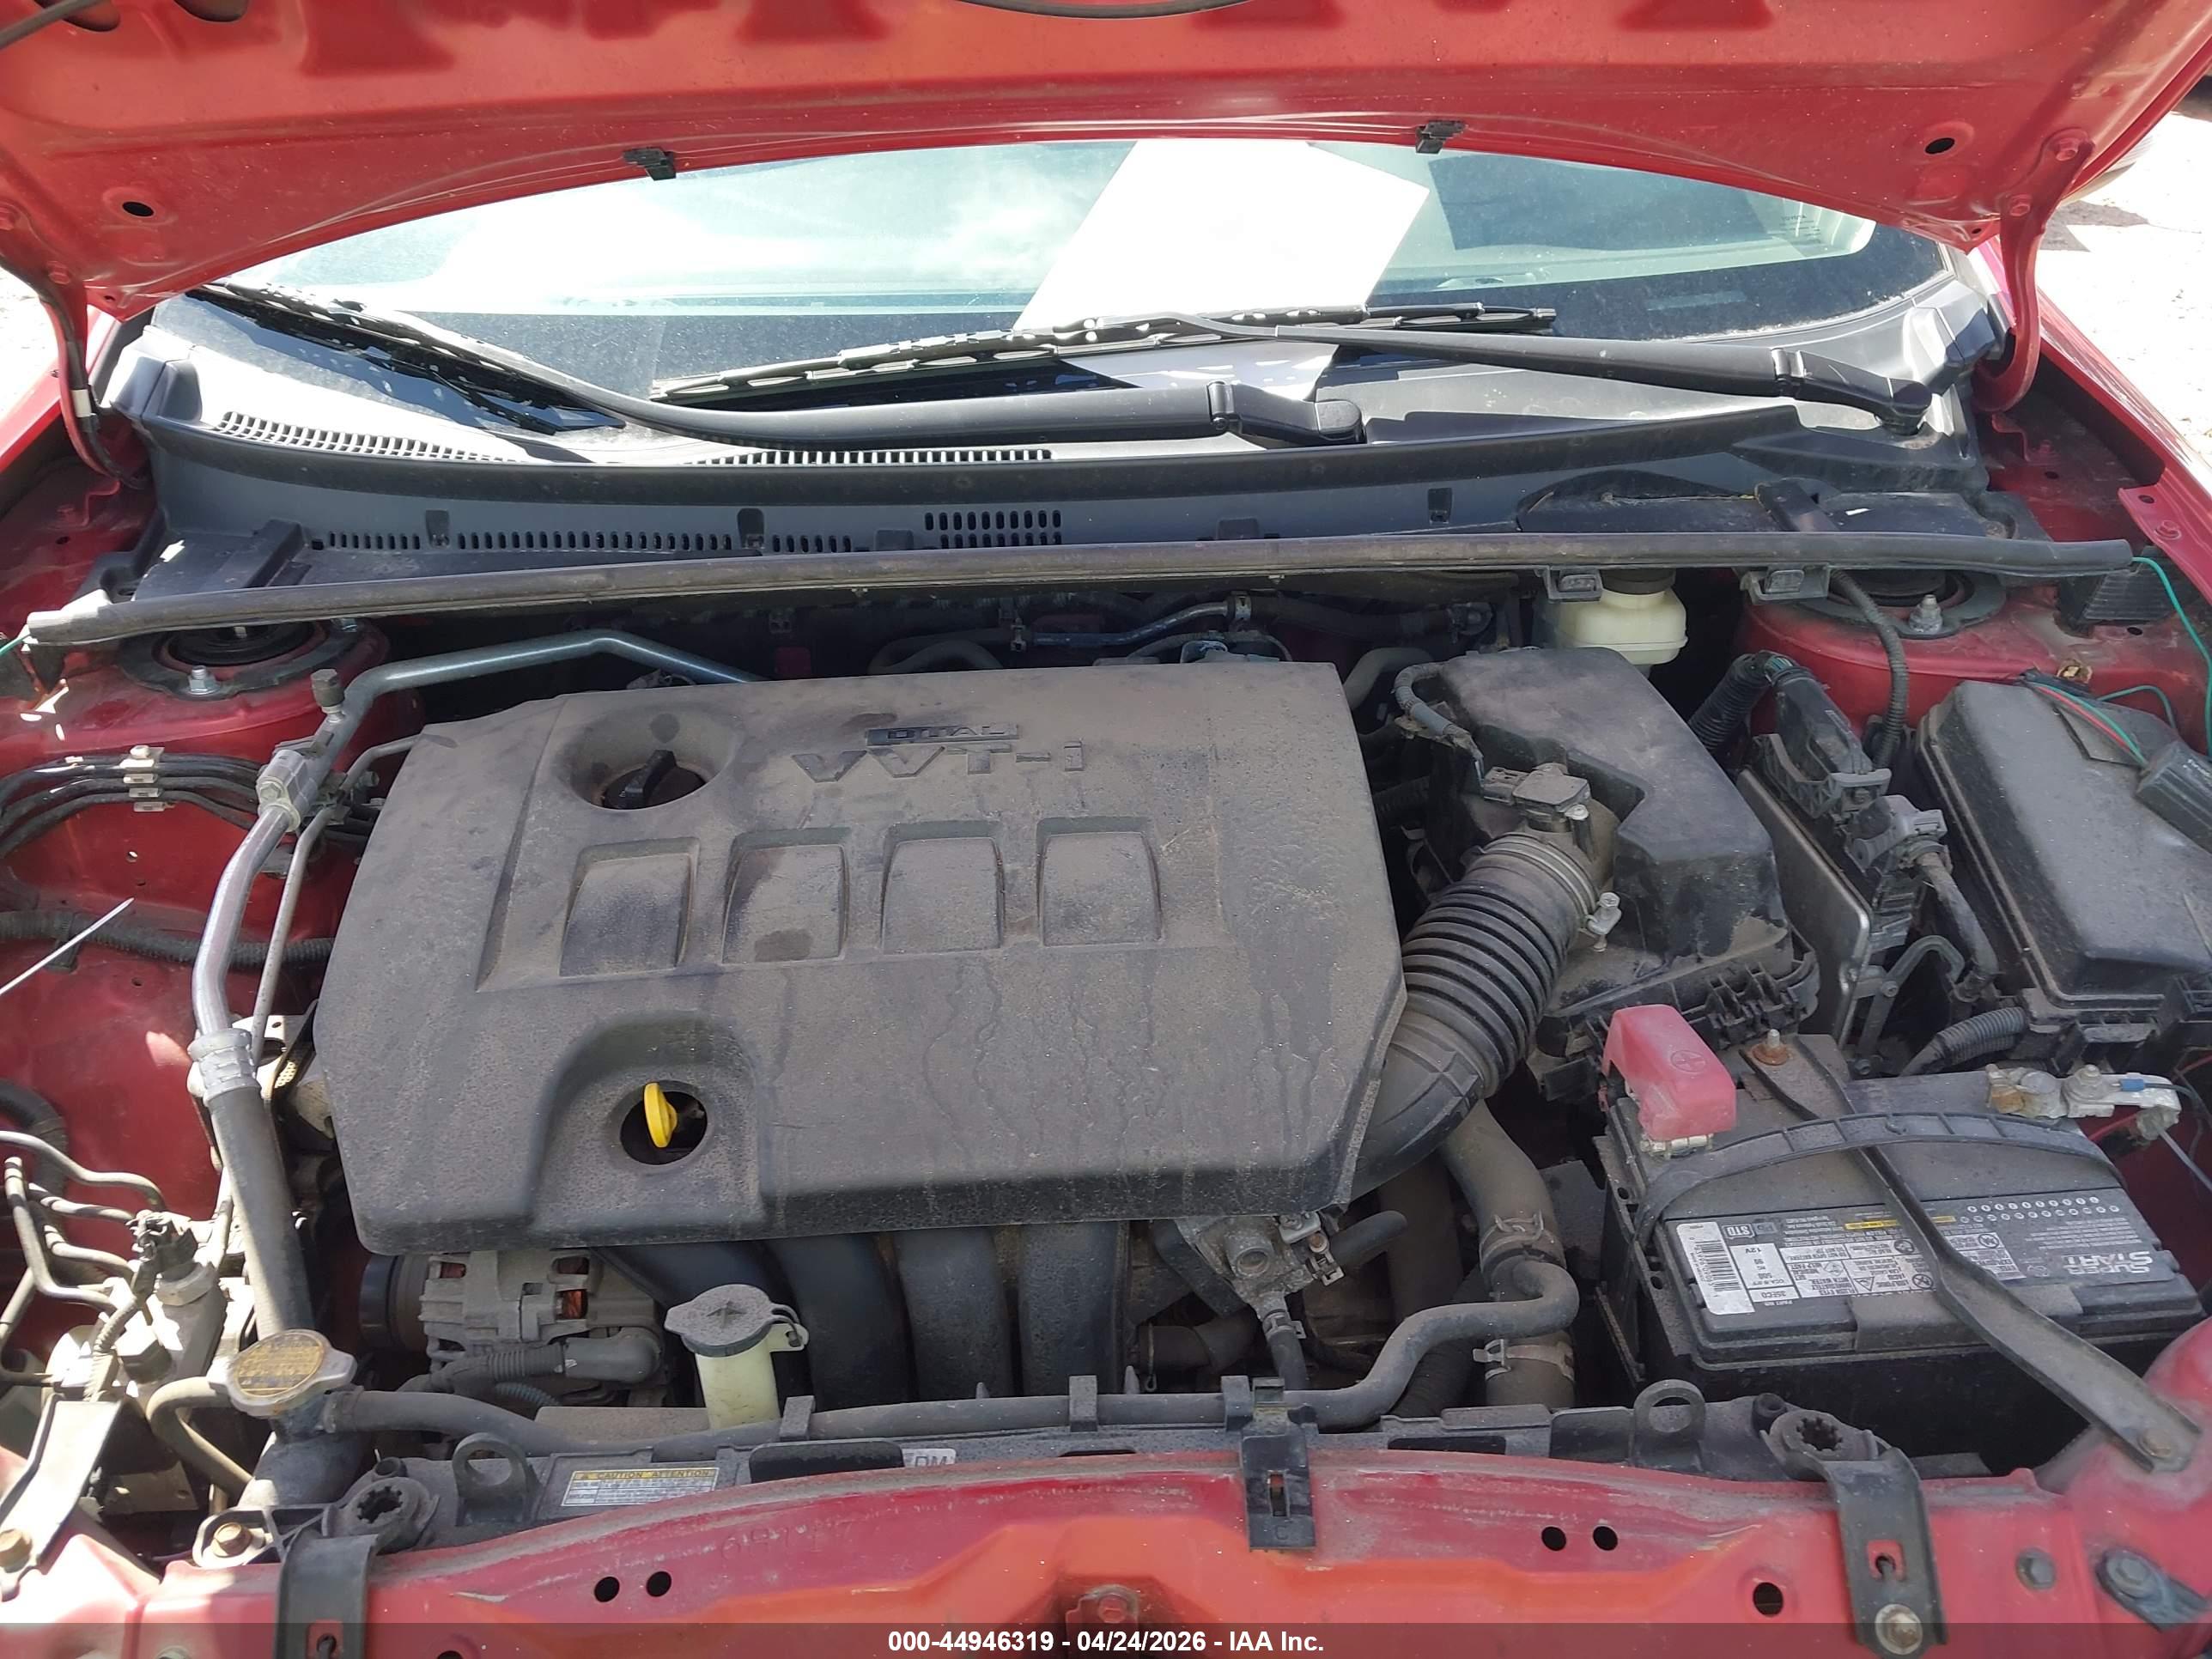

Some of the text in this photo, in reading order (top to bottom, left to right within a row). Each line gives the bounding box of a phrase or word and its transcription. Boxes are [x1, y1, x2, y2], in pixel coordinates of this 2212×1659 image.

[1726, 1225, 1751, 1237] STD
[2061, 1251, 2154, 1267] START
[2063, 1264, 2150, 1275] SUPER
[598, 1469, 709, 1480] CAUTION ATTENTION
